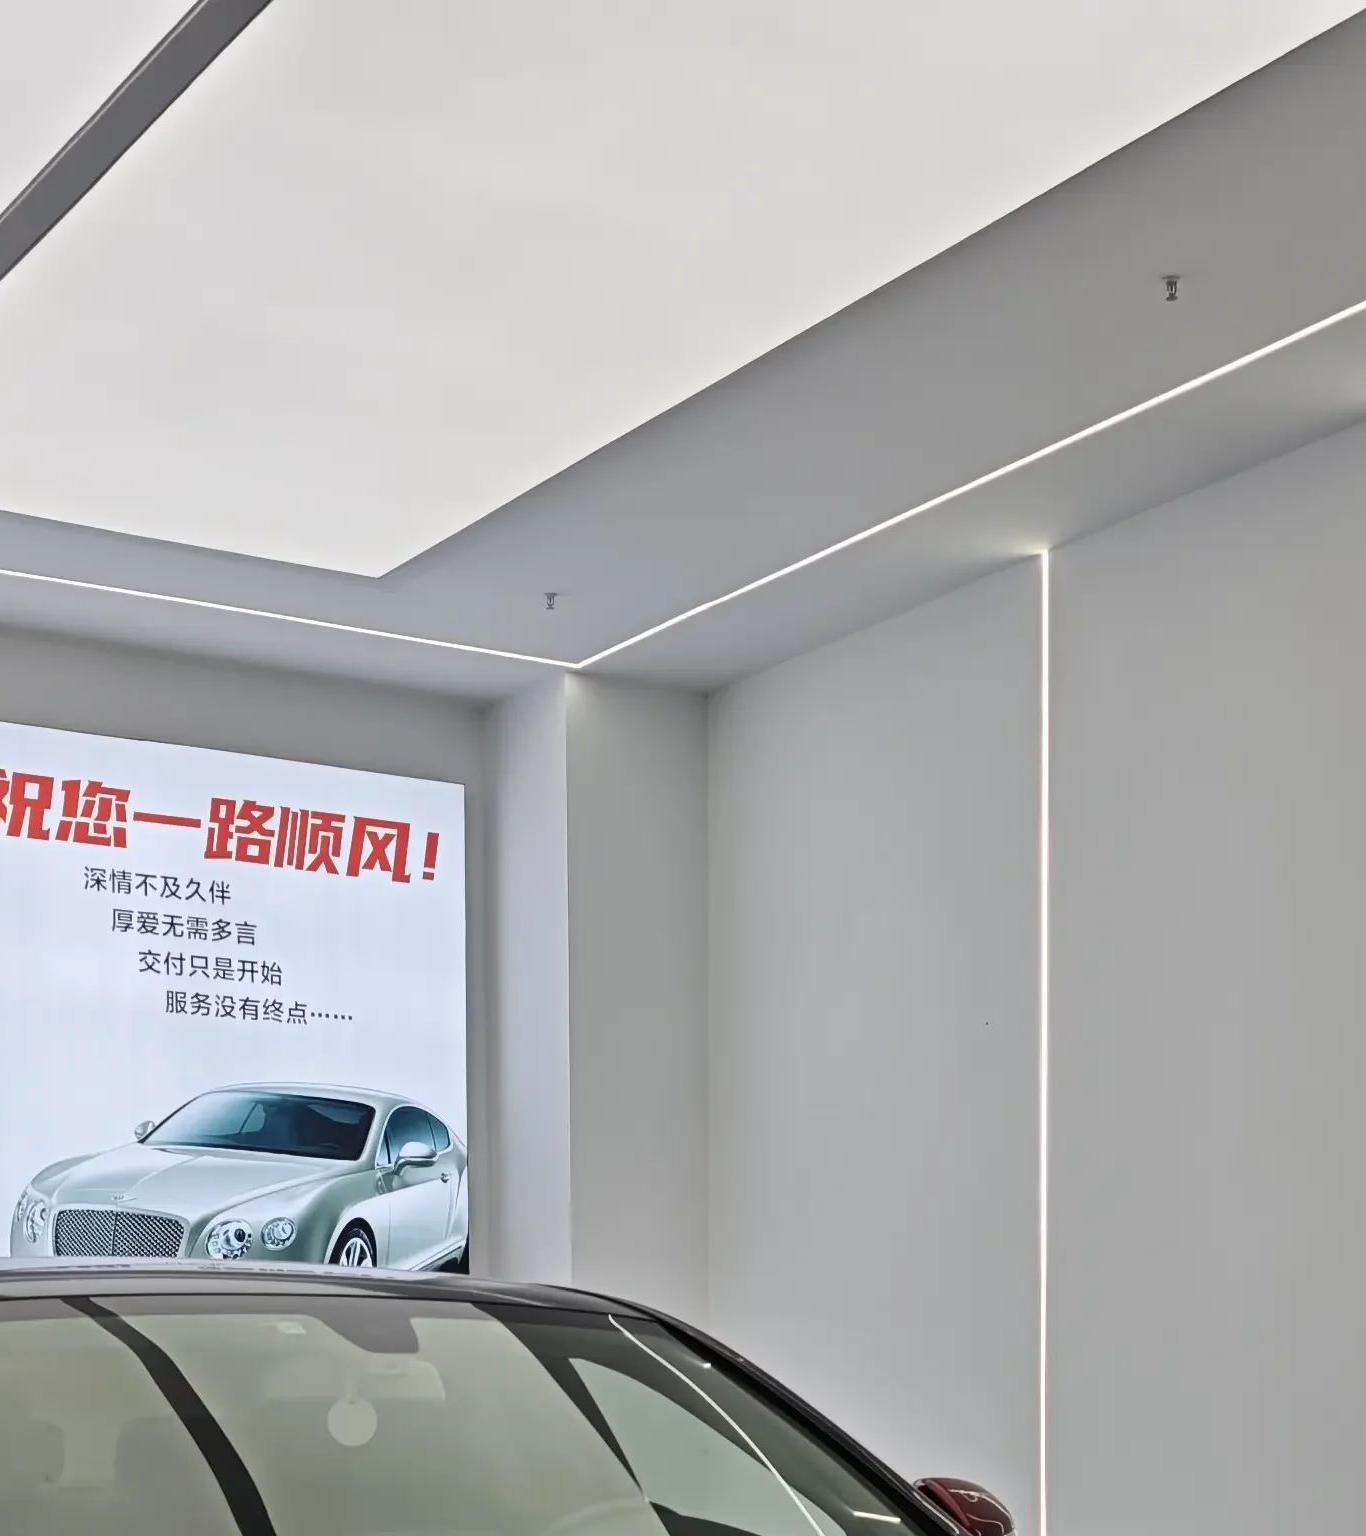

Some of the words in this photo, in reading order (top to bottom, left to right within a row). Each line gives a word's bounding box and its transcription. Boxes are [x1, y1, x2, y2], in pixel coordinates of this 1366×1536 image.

[83, 866, 232, 905] 深情不及久伴
[111, 908, 257, 946] 厚爱无需多言
[138, 949, 283, 986] 交付只是开始
